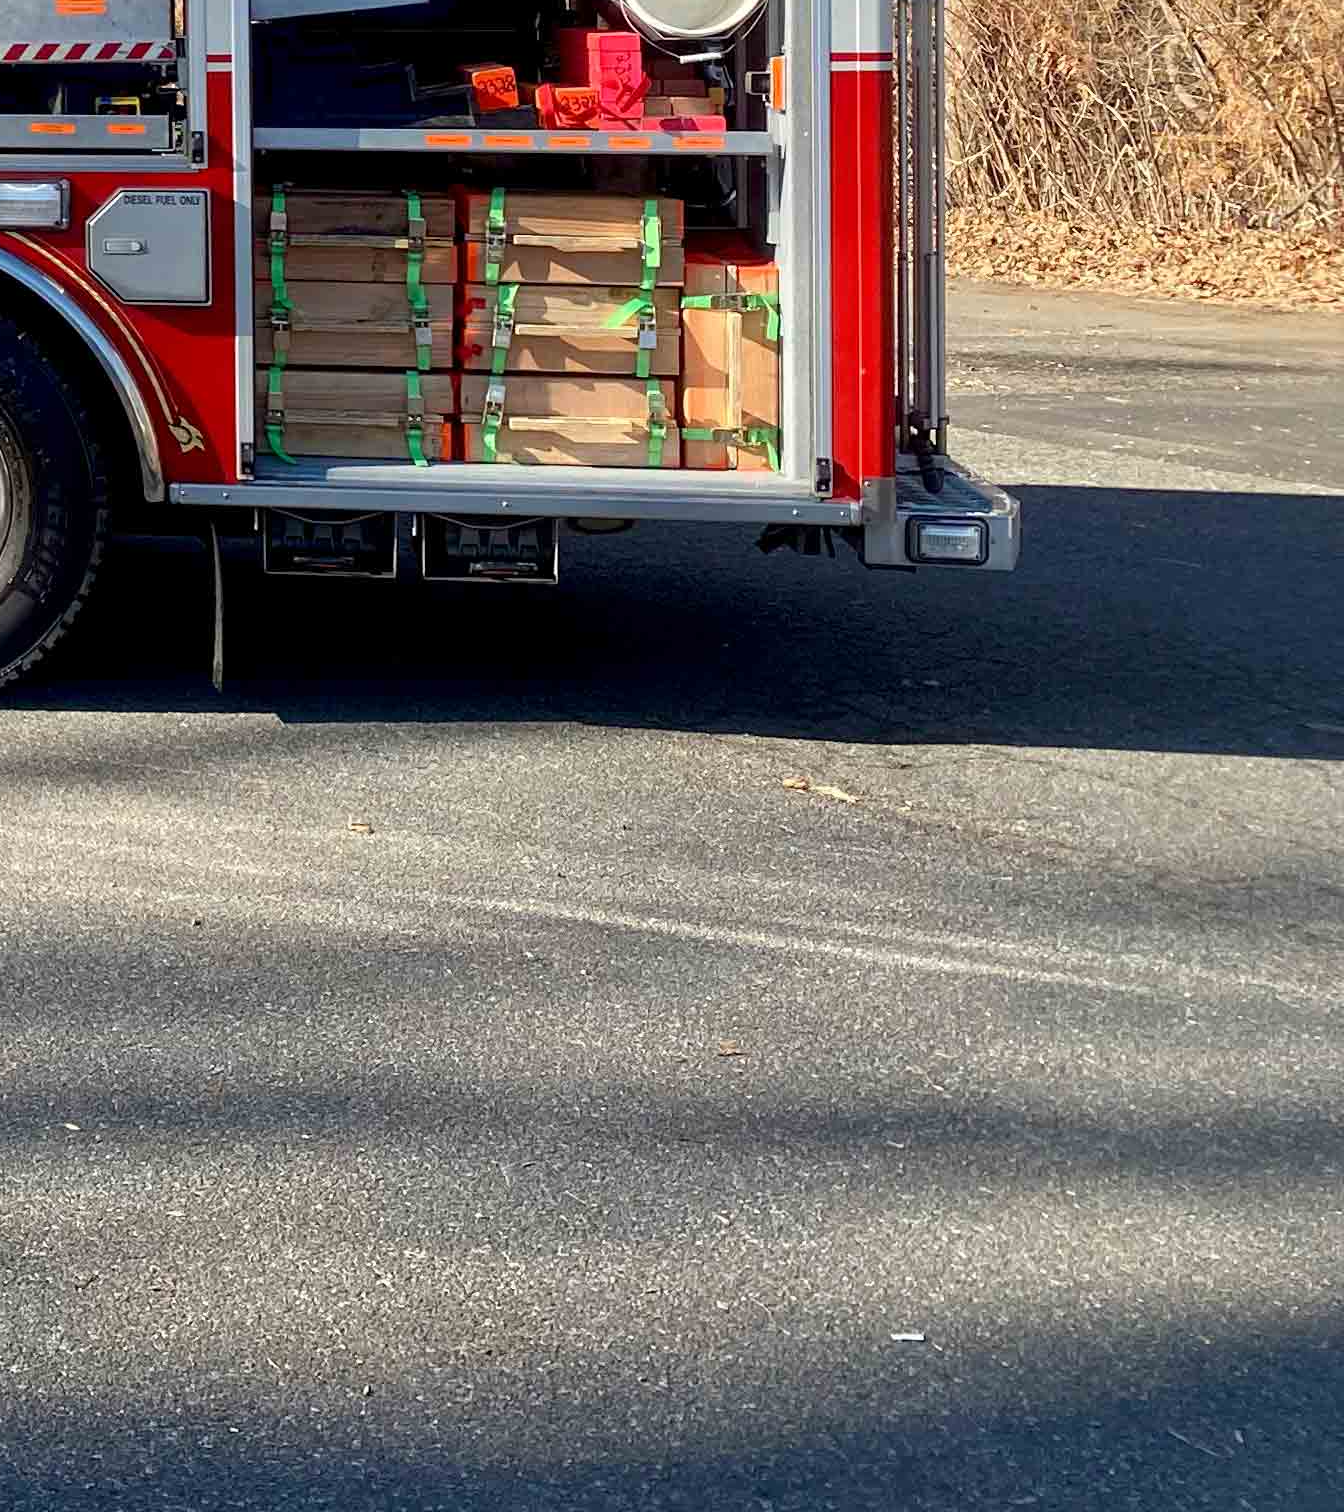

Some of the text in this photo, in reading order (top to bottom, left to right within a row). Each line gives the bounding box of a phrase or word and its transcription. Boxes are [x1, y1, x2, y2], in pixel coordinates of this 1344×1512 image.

[123, 195, 201, 206] DIESEL FUEL ONLY
